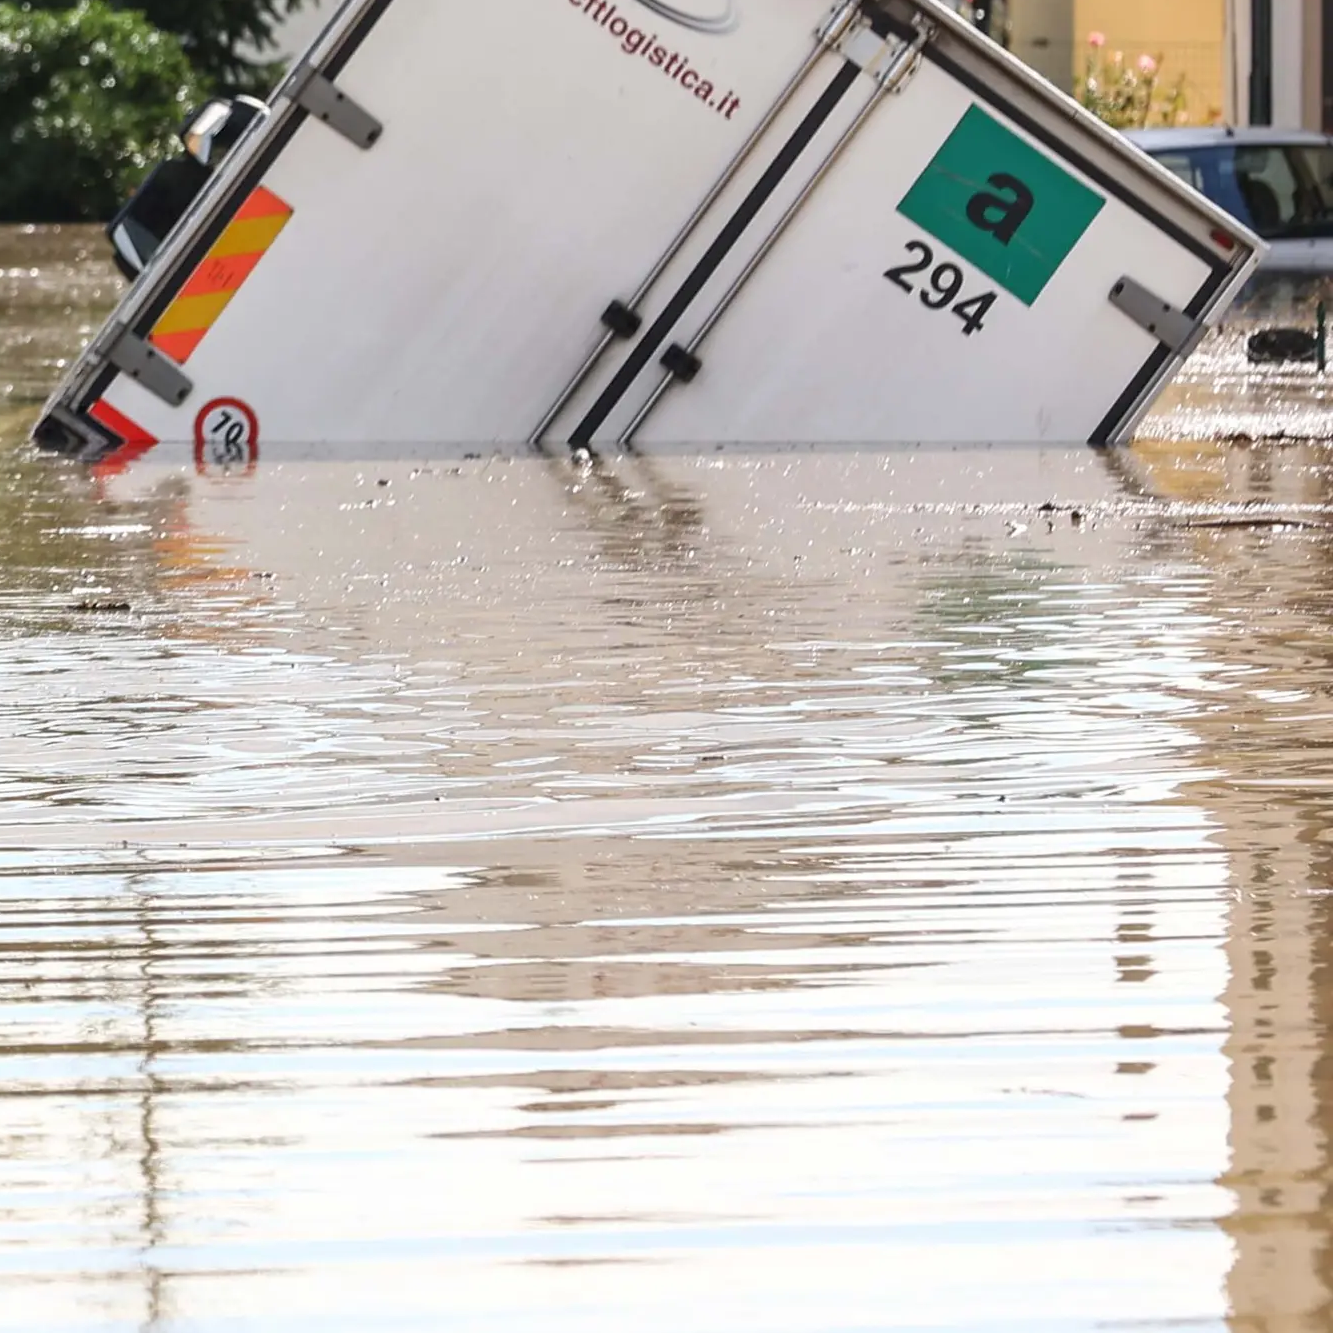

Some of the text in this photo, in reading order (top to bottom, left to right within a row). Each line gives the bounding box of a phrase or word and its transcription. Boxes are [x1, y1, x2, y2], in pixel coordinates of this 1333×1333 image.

[966, 172, 1034, 247] a
[883, 239, 998, 338] 294
[211, 410, 244, 445] 70
